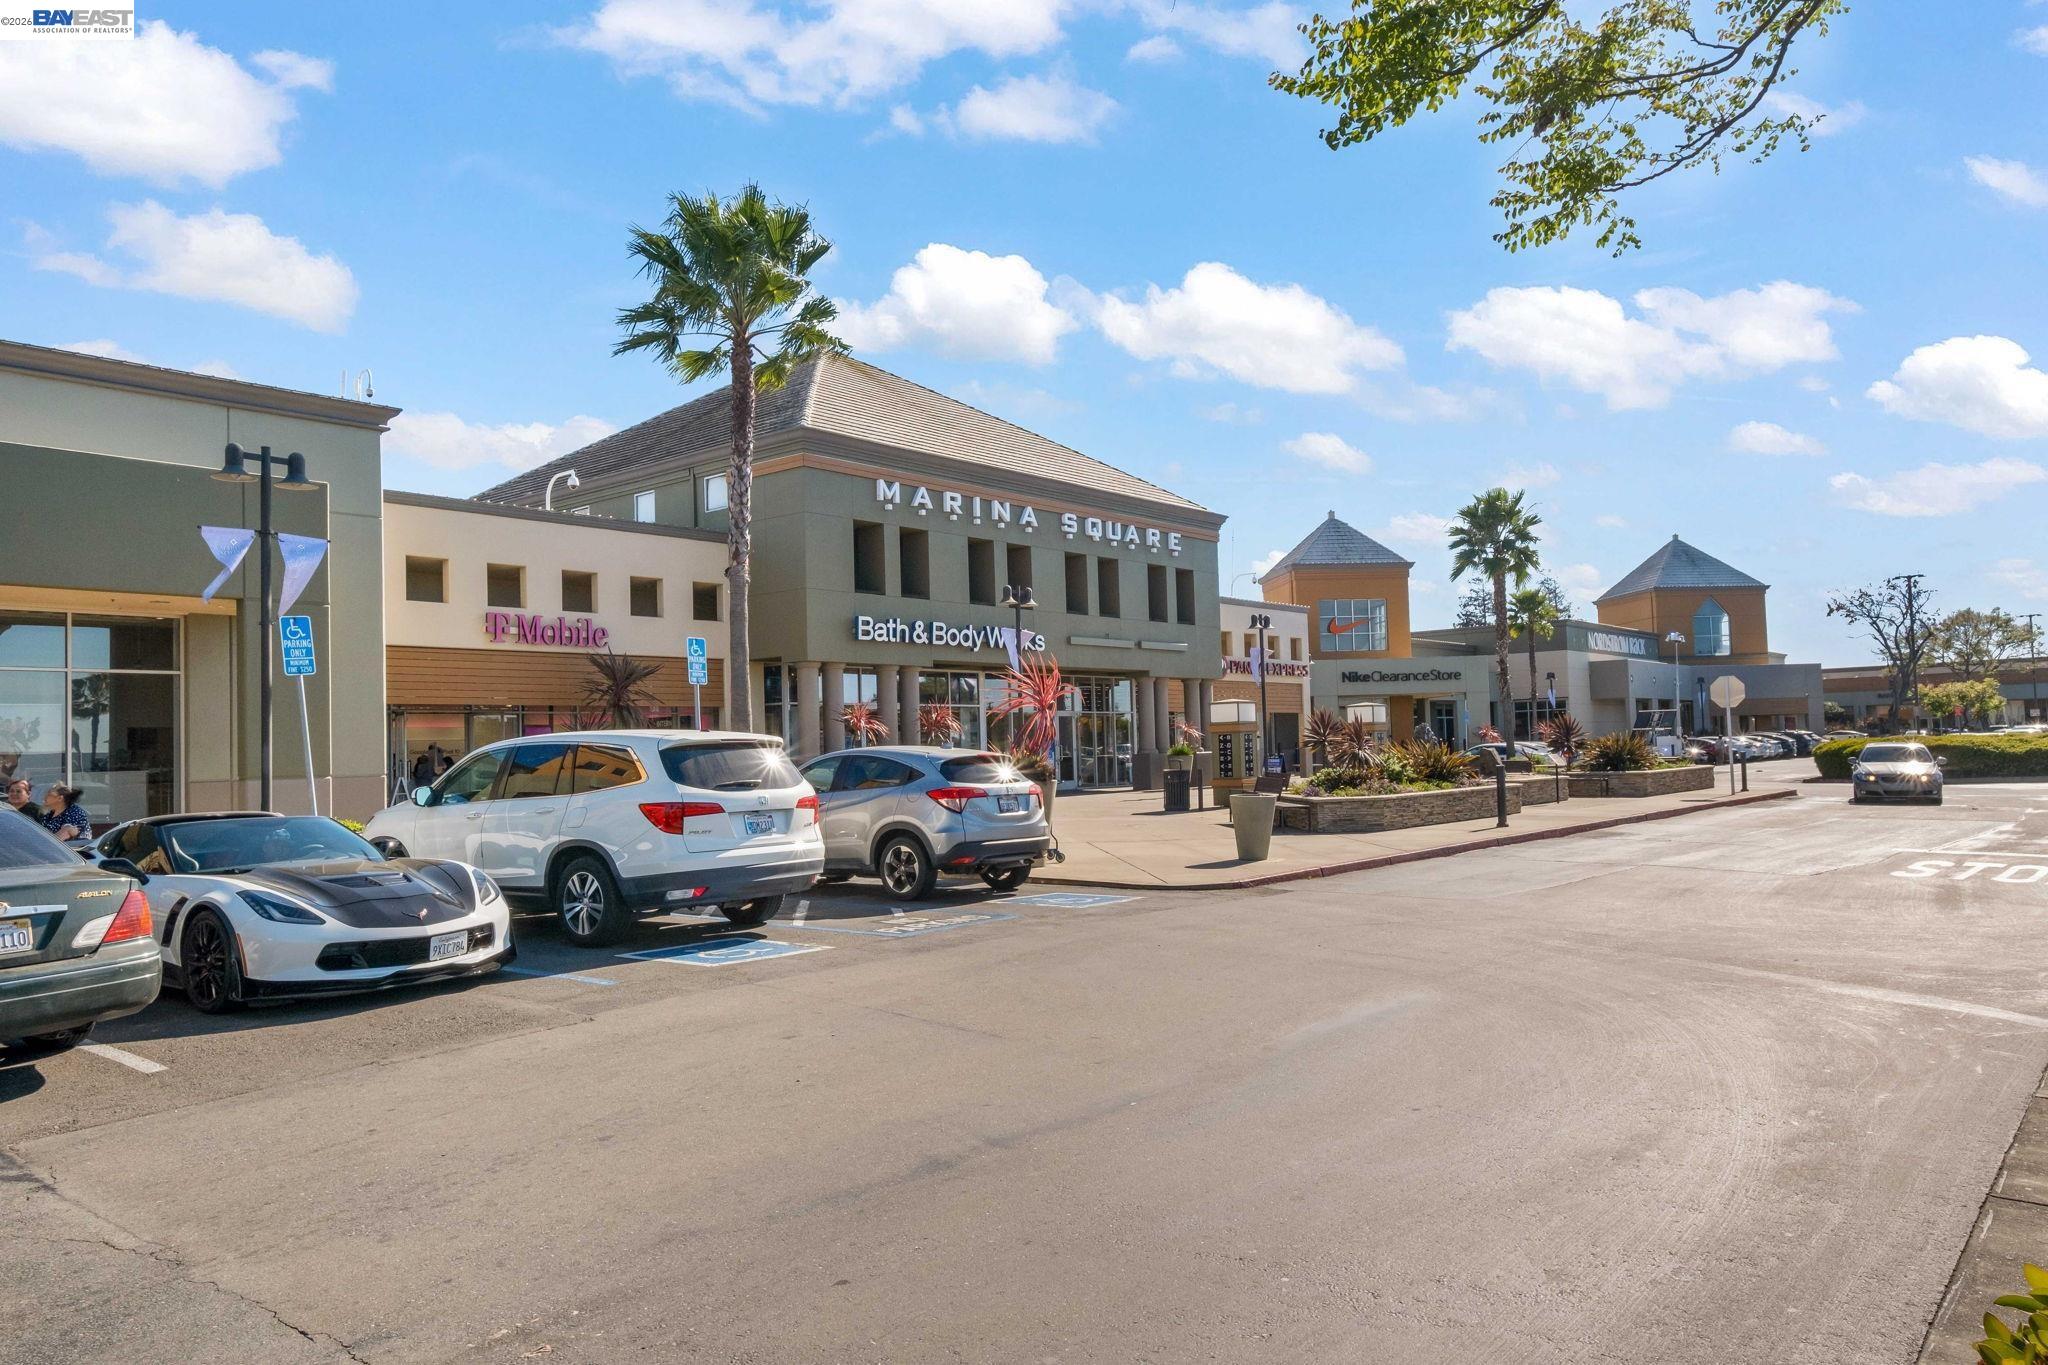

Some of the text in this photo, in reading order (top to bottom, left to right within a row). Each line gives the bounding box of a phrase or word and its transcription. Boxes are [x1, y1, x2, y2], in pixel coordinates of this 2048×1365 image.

[876, 479, 1182, 553] MARINA SQUARE
[857, 616, 1046, 652] Bath & Body Wks
[283, 639, 312, 648] PARKING
[290, 648, 306, 657] ONLY
[1341, 669, 1462, 683] Nike Clearance Store
[1889, 860, 2048, 886] STO
[76, 889, 113, 899] AVALON
